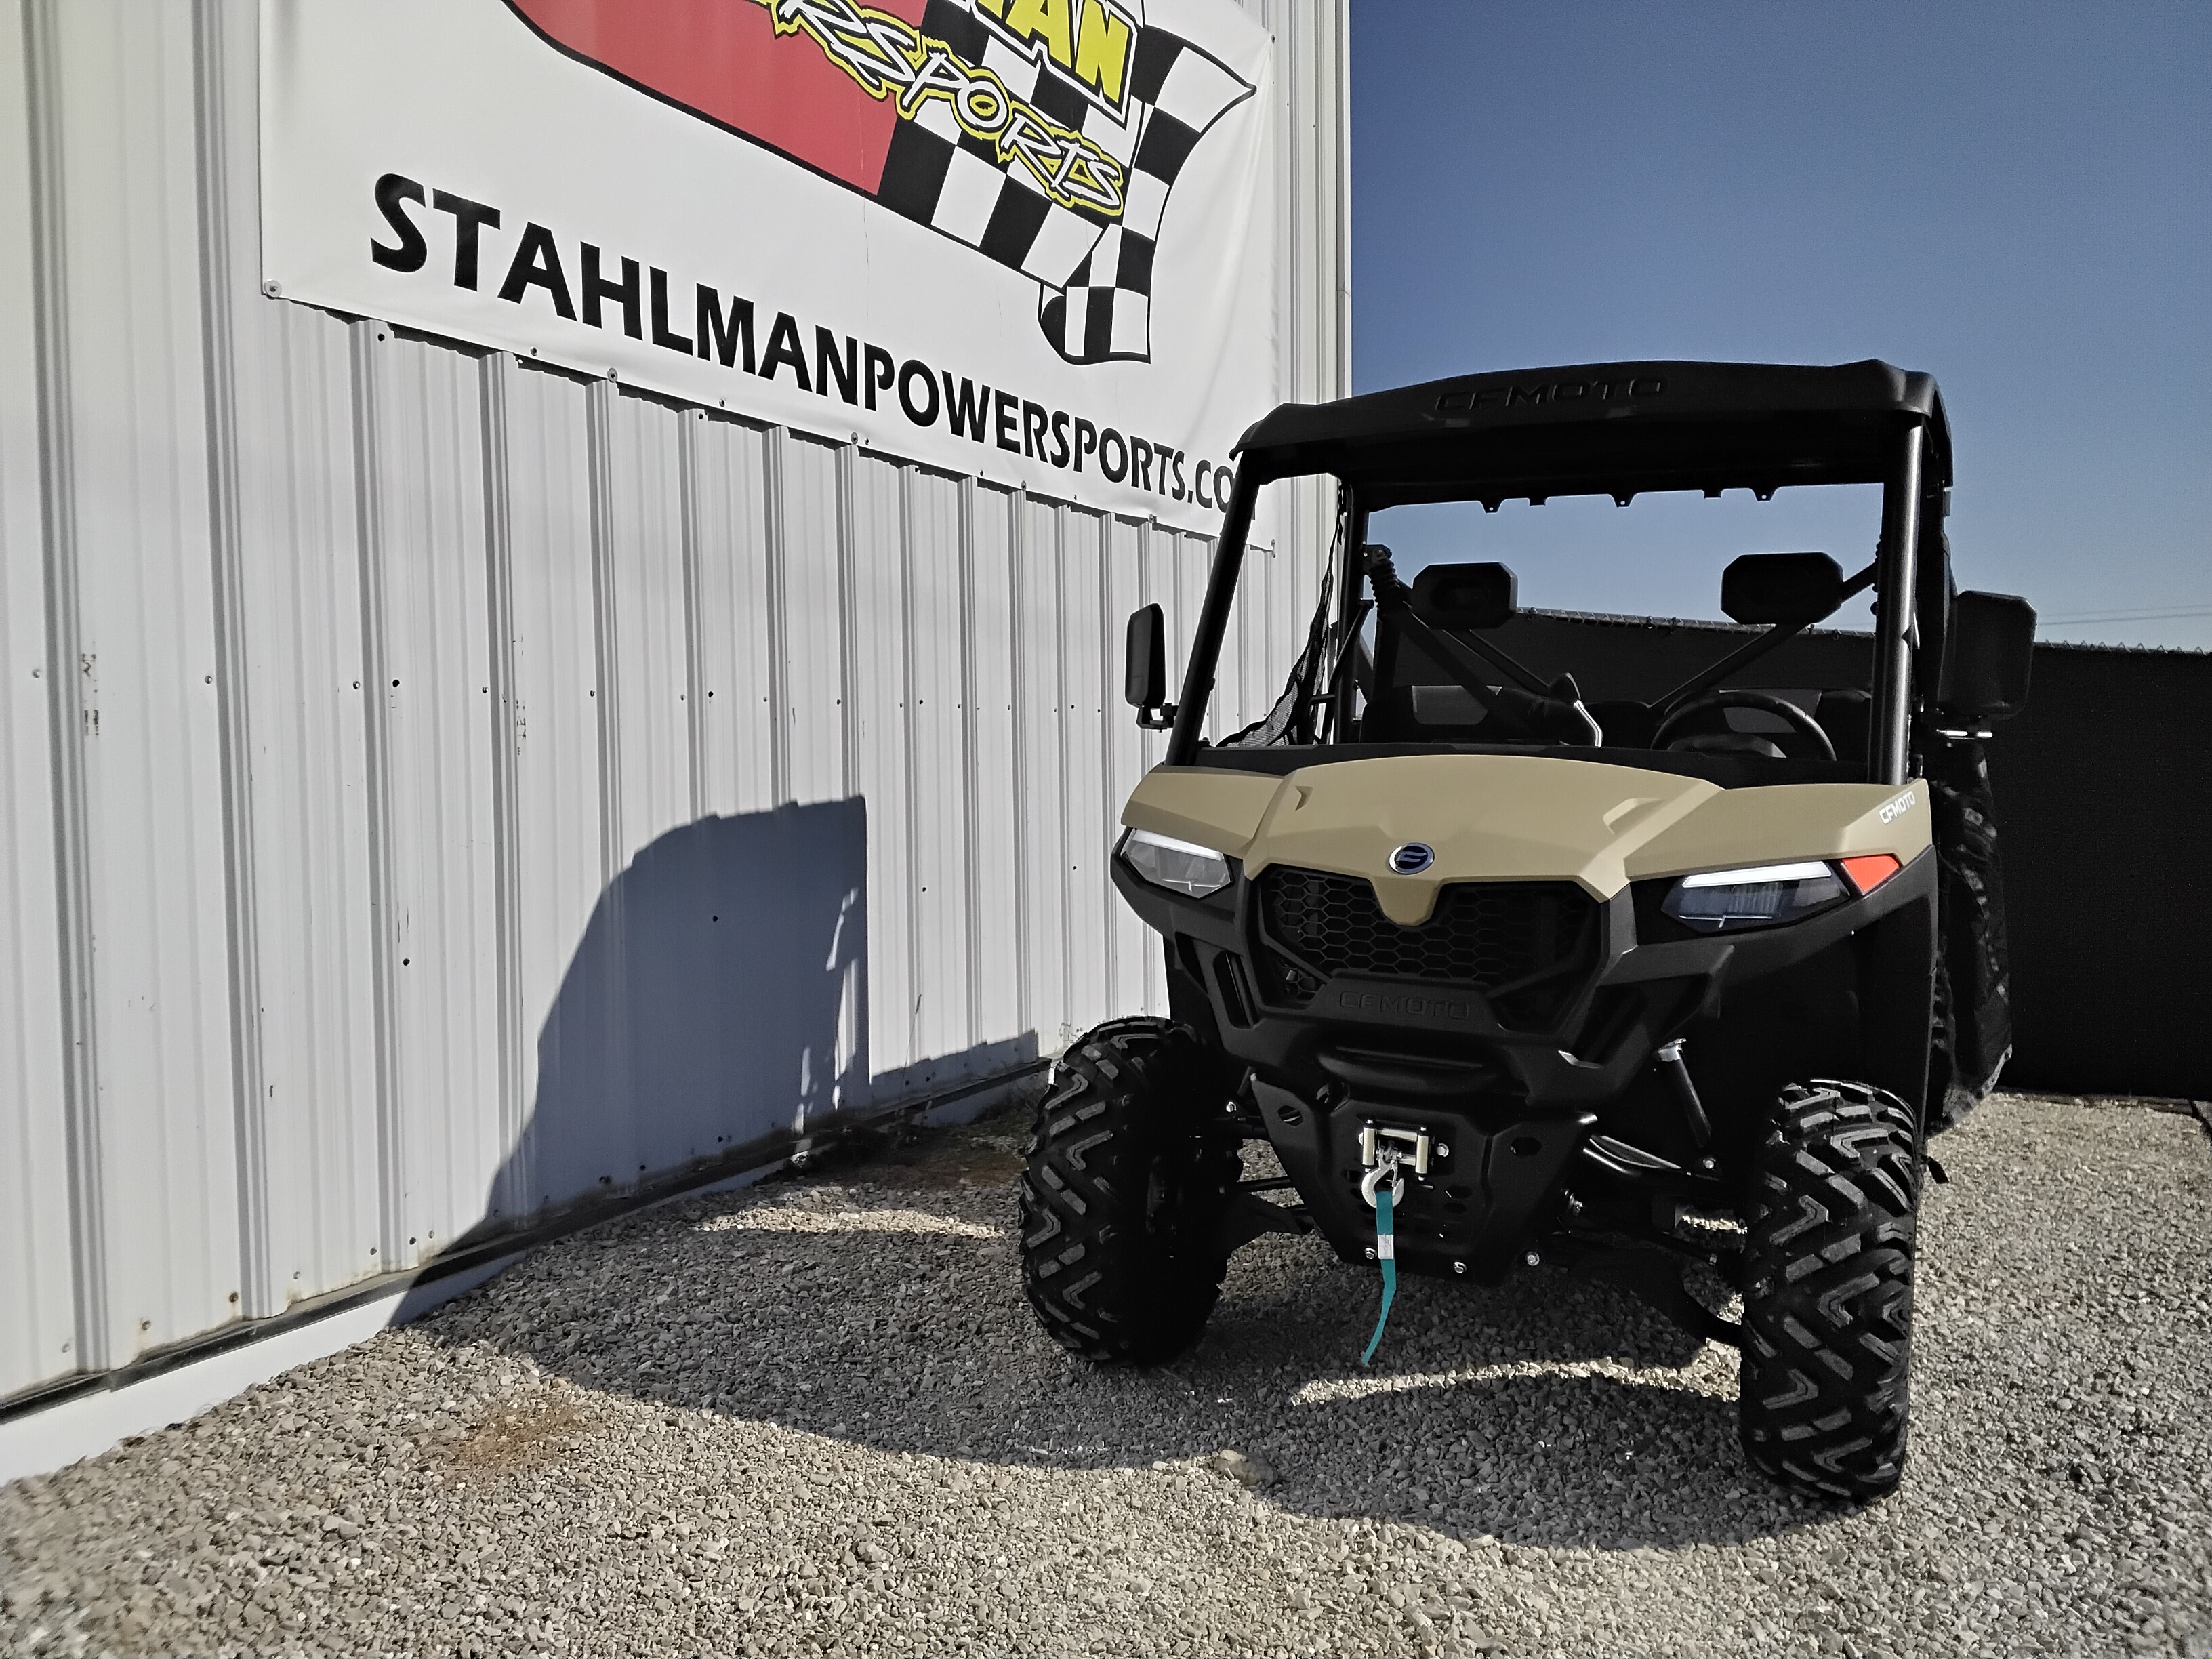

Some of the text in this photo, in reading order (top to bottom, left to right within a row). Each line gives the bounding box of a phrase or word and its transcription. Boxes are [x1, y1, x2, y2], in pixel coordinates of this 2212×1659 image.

[979, 0, 1129, 103] AN
[370, 173, 1255, 520] STAHLMANPOWERSPORTS.CO
[1435, 375, 1667, 412] CFMOTO
[1879, 790, 1916, 825] CFMOTO
[1339, 991, 1469, 1020] CFMOTO
